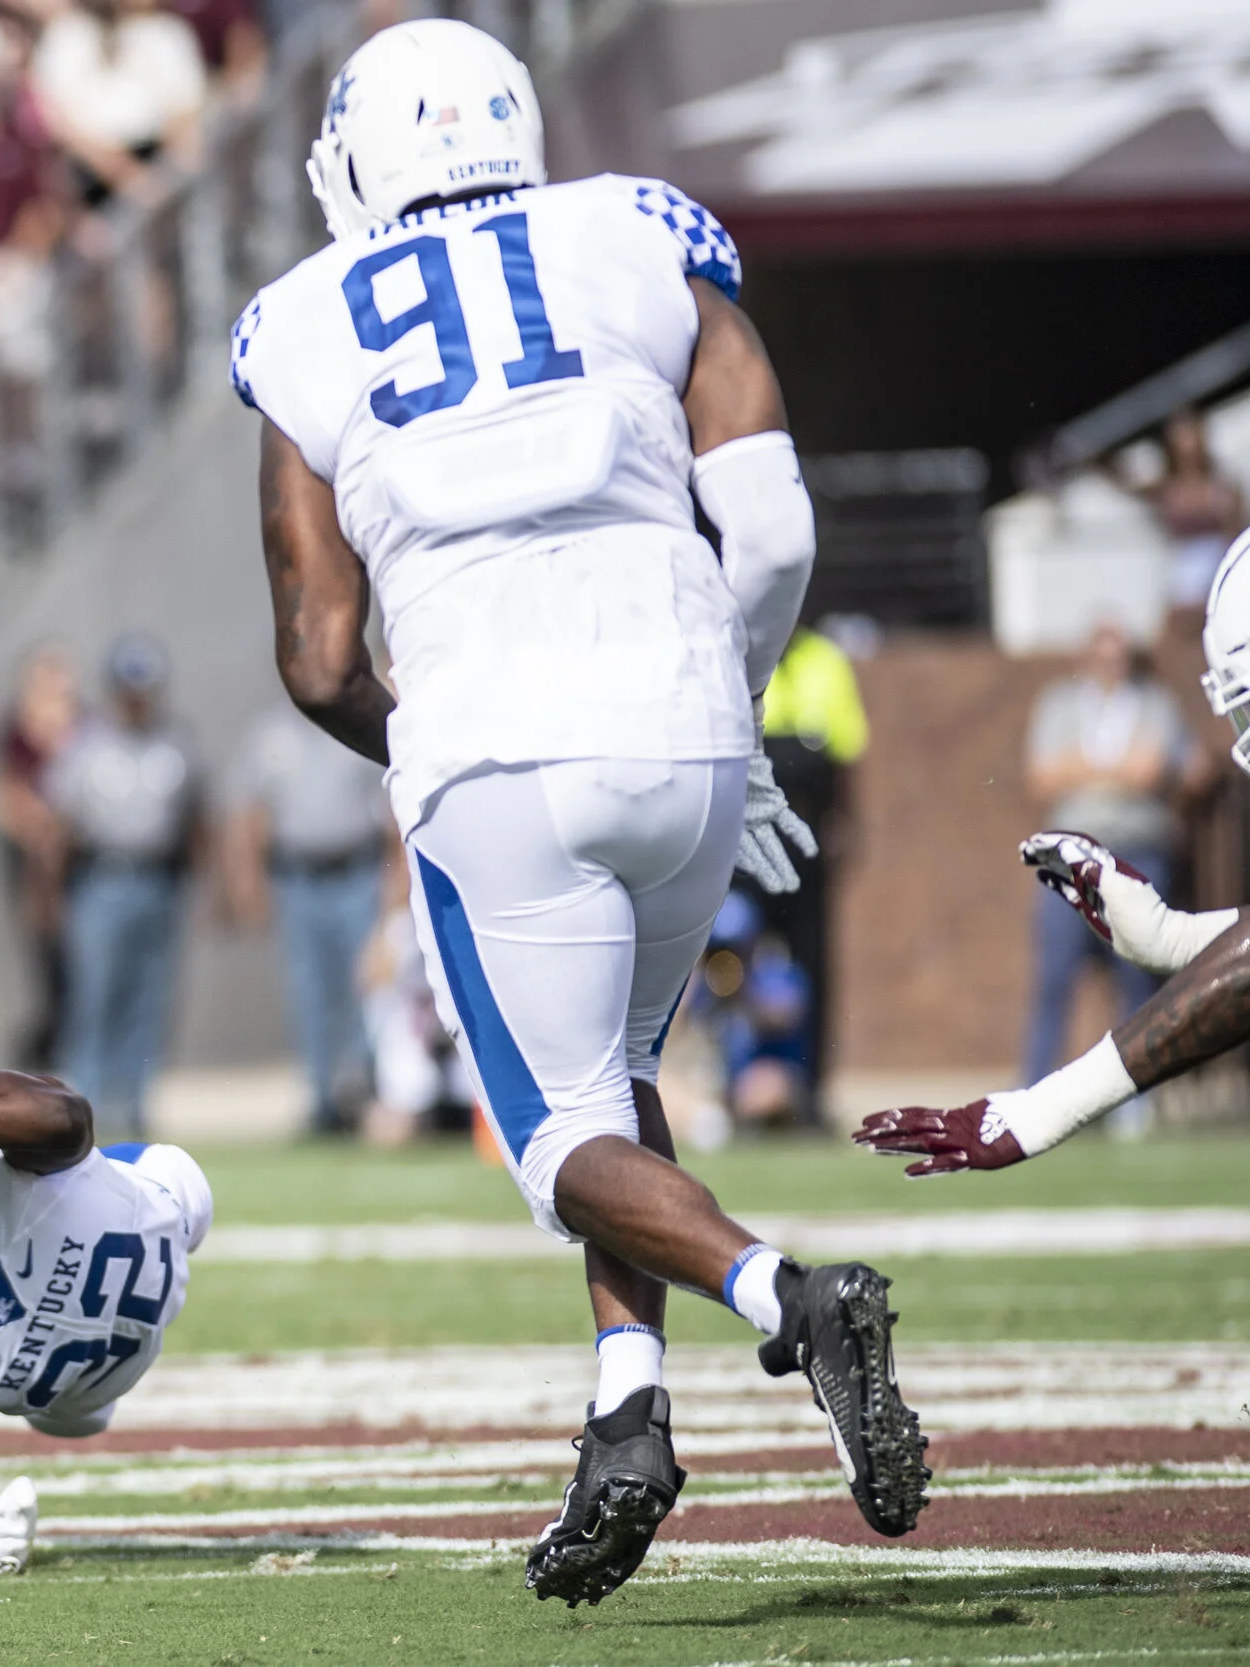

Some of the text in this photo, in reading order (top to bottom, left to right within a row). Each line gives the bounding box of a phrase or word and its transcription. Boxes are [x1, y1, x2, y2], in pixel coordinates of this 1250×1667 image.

[341, 212, 584, 428] 91
[0, 1236, 85, 1391] KENTUCKY
[26, 1231, 173, 1408] 22
